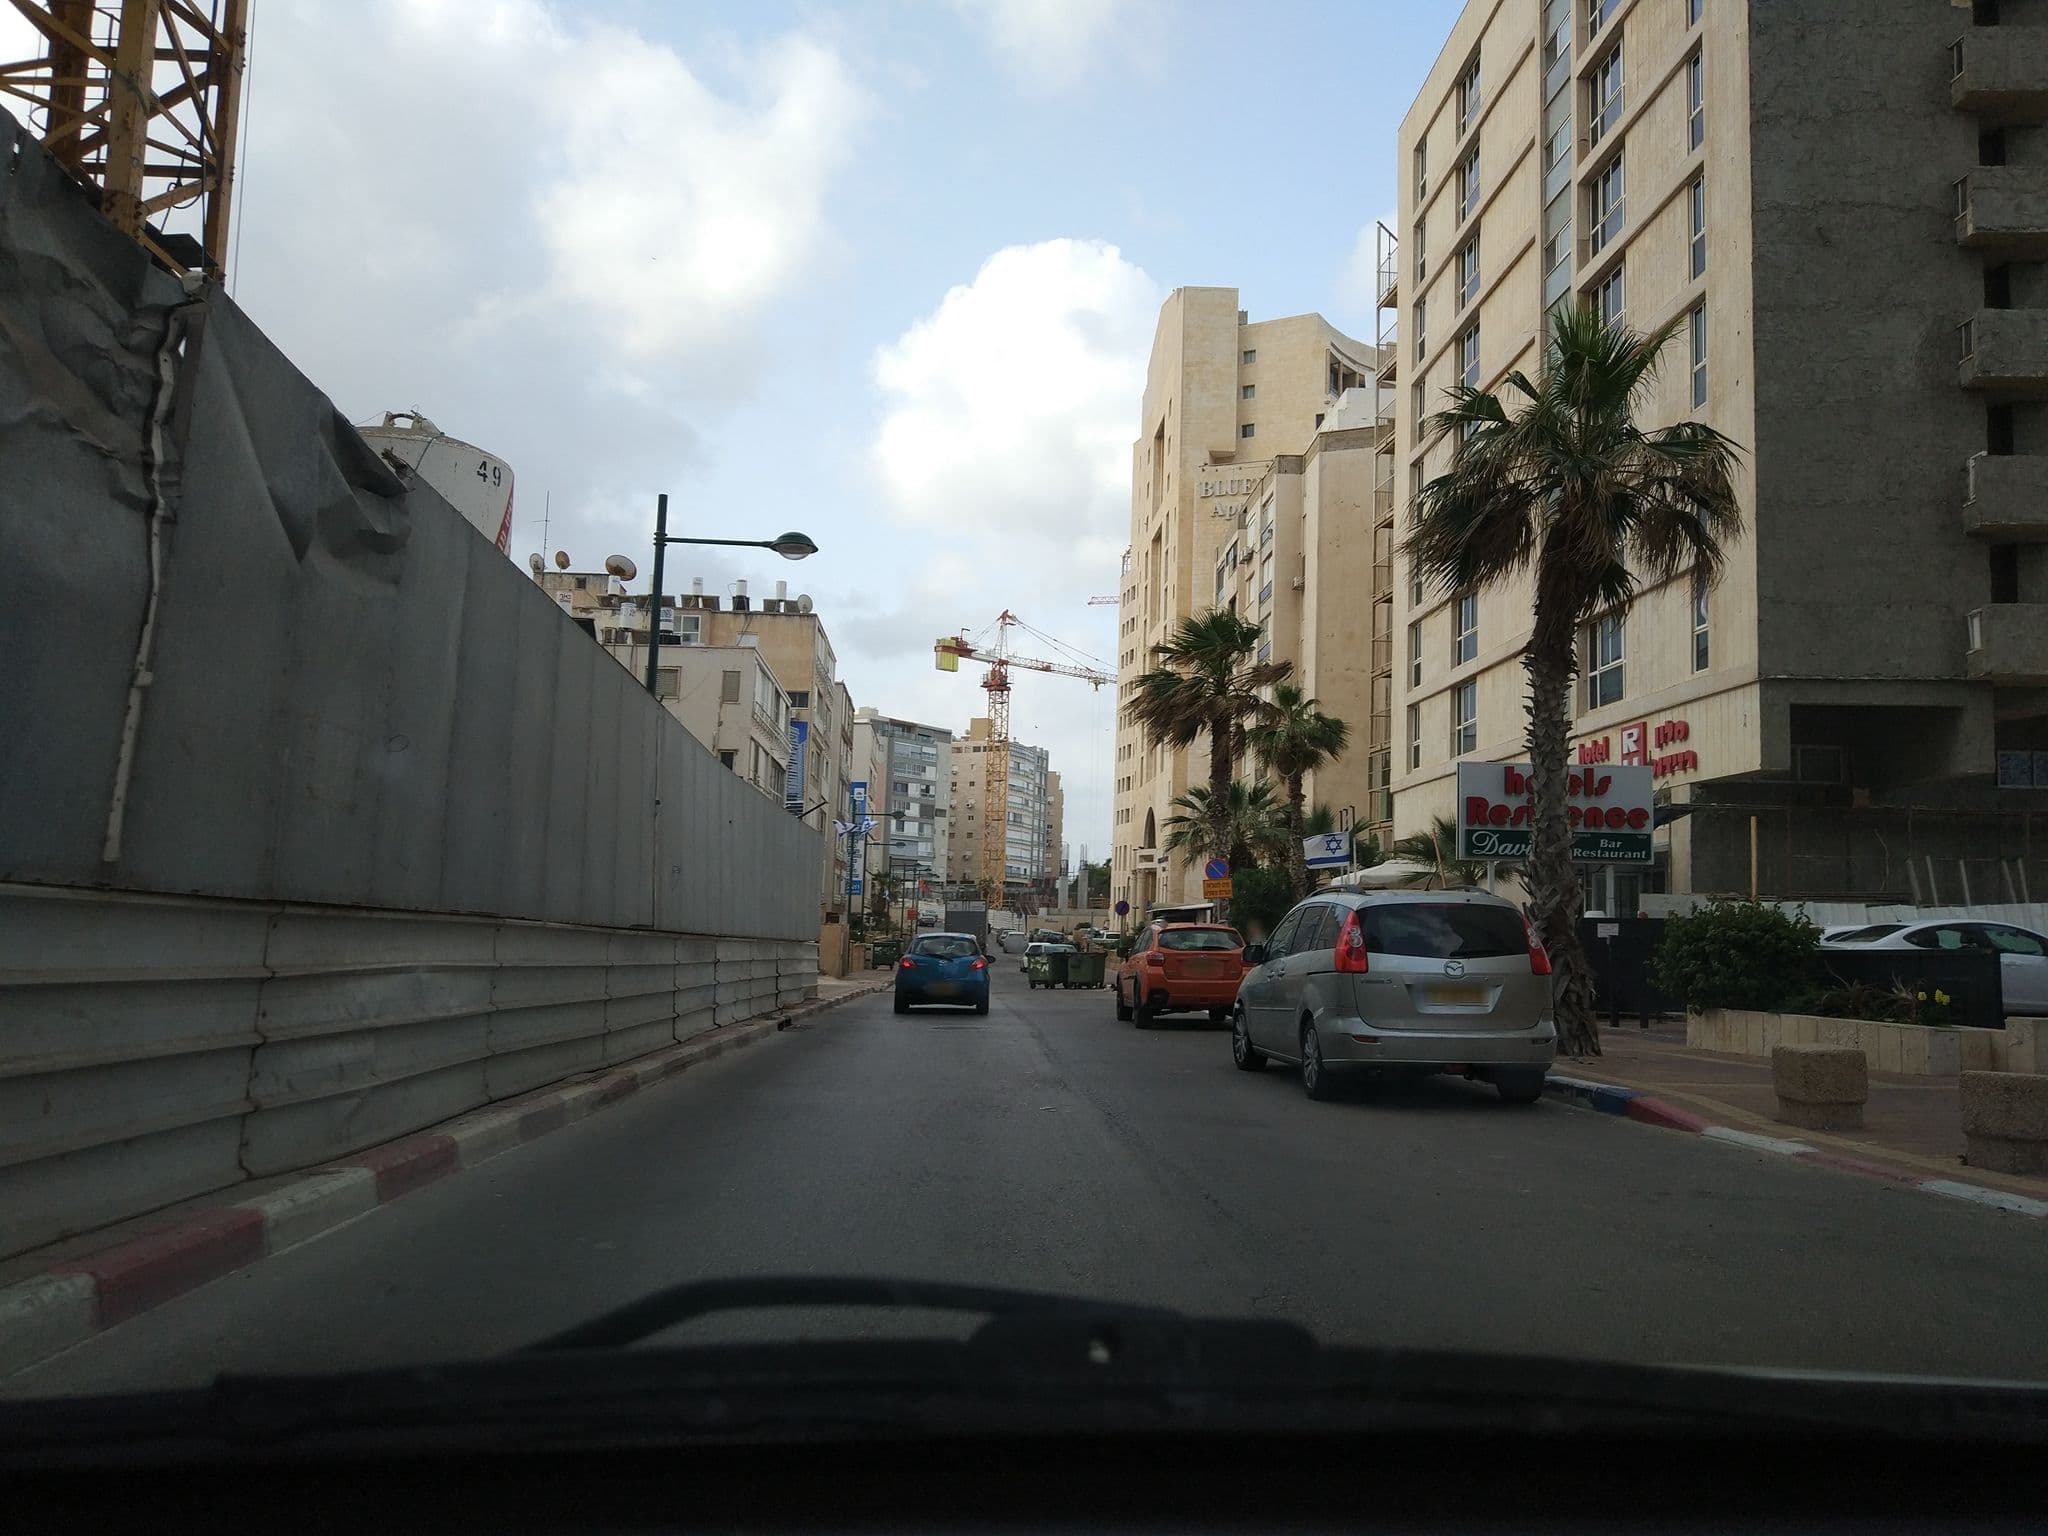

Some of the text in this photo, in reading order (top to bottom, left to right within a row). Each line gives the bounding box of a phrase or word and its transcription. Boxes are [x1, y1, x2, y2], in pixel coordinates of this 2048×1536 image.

[477, 460, 501, 487] 49
[1578, 737, 1609, 764] hotel
[1622, 728, 1640, 754] R
[1504, 766, 1612, 797] hels
[1466, 796, 1649, 829] Resience
[1573, 848, 1647, 859] Restaurant
[1600, 838, 1623, 848] Bar
